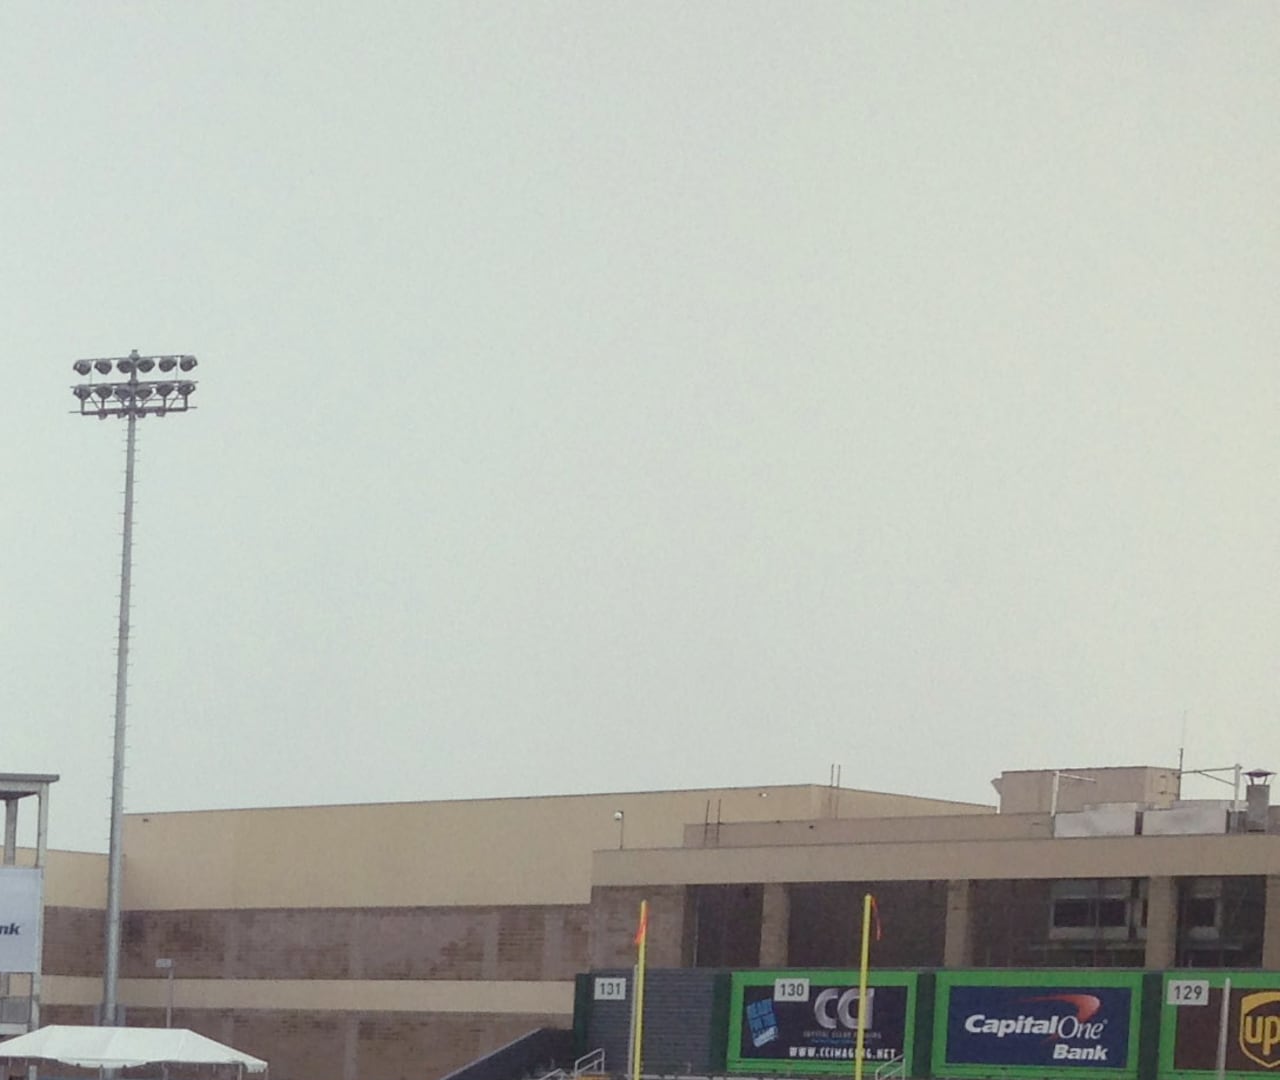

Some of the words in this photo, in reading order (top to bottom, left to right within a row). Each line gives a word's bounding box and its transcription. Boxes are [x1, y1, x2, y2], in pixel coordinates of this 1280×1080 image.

[599, 982, 622, 996] 131
[780, 983, 805, 997] 130
[1174, 985, 1203, 1000] 129
[1053, 1044, 1107, 1060] Bank
